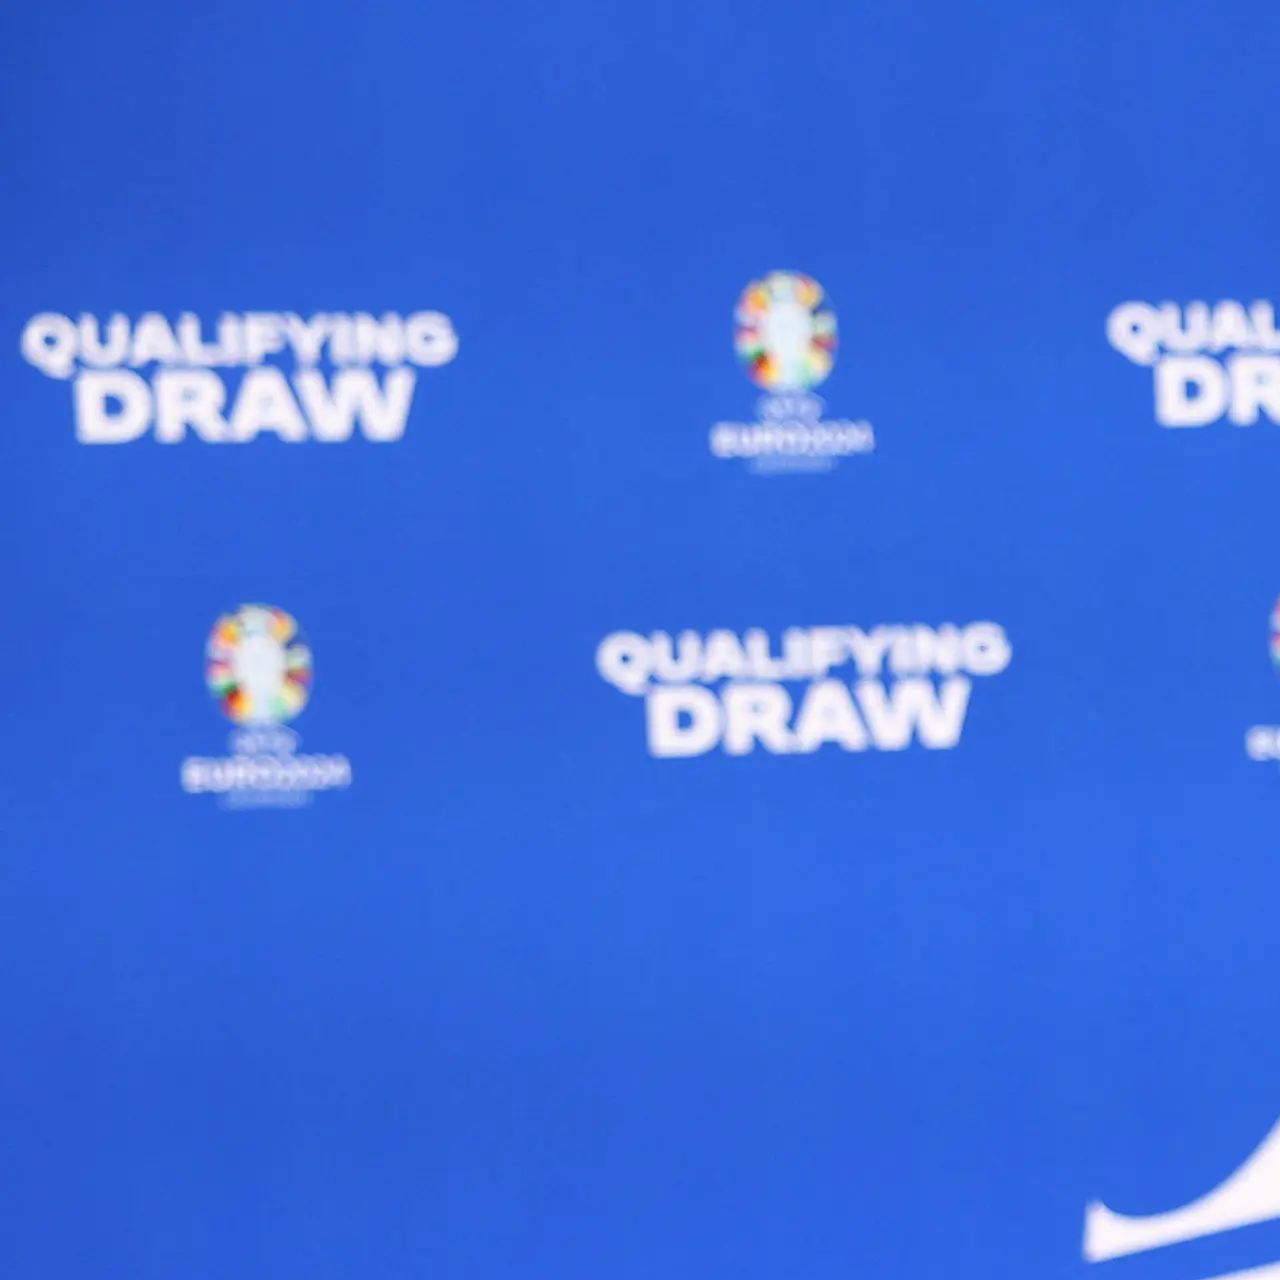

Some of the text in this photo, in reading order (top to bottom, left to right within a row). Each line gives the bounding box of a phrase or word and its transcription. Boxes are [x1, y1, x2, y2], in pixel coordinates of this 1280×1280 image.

[22, 312, 458, 378] QUALIFYING
[74, 368, 416, 444] DRAW
[597, 622, 1011, 694] QUALIFYING
[647, 678, 970, 757] DRAW
